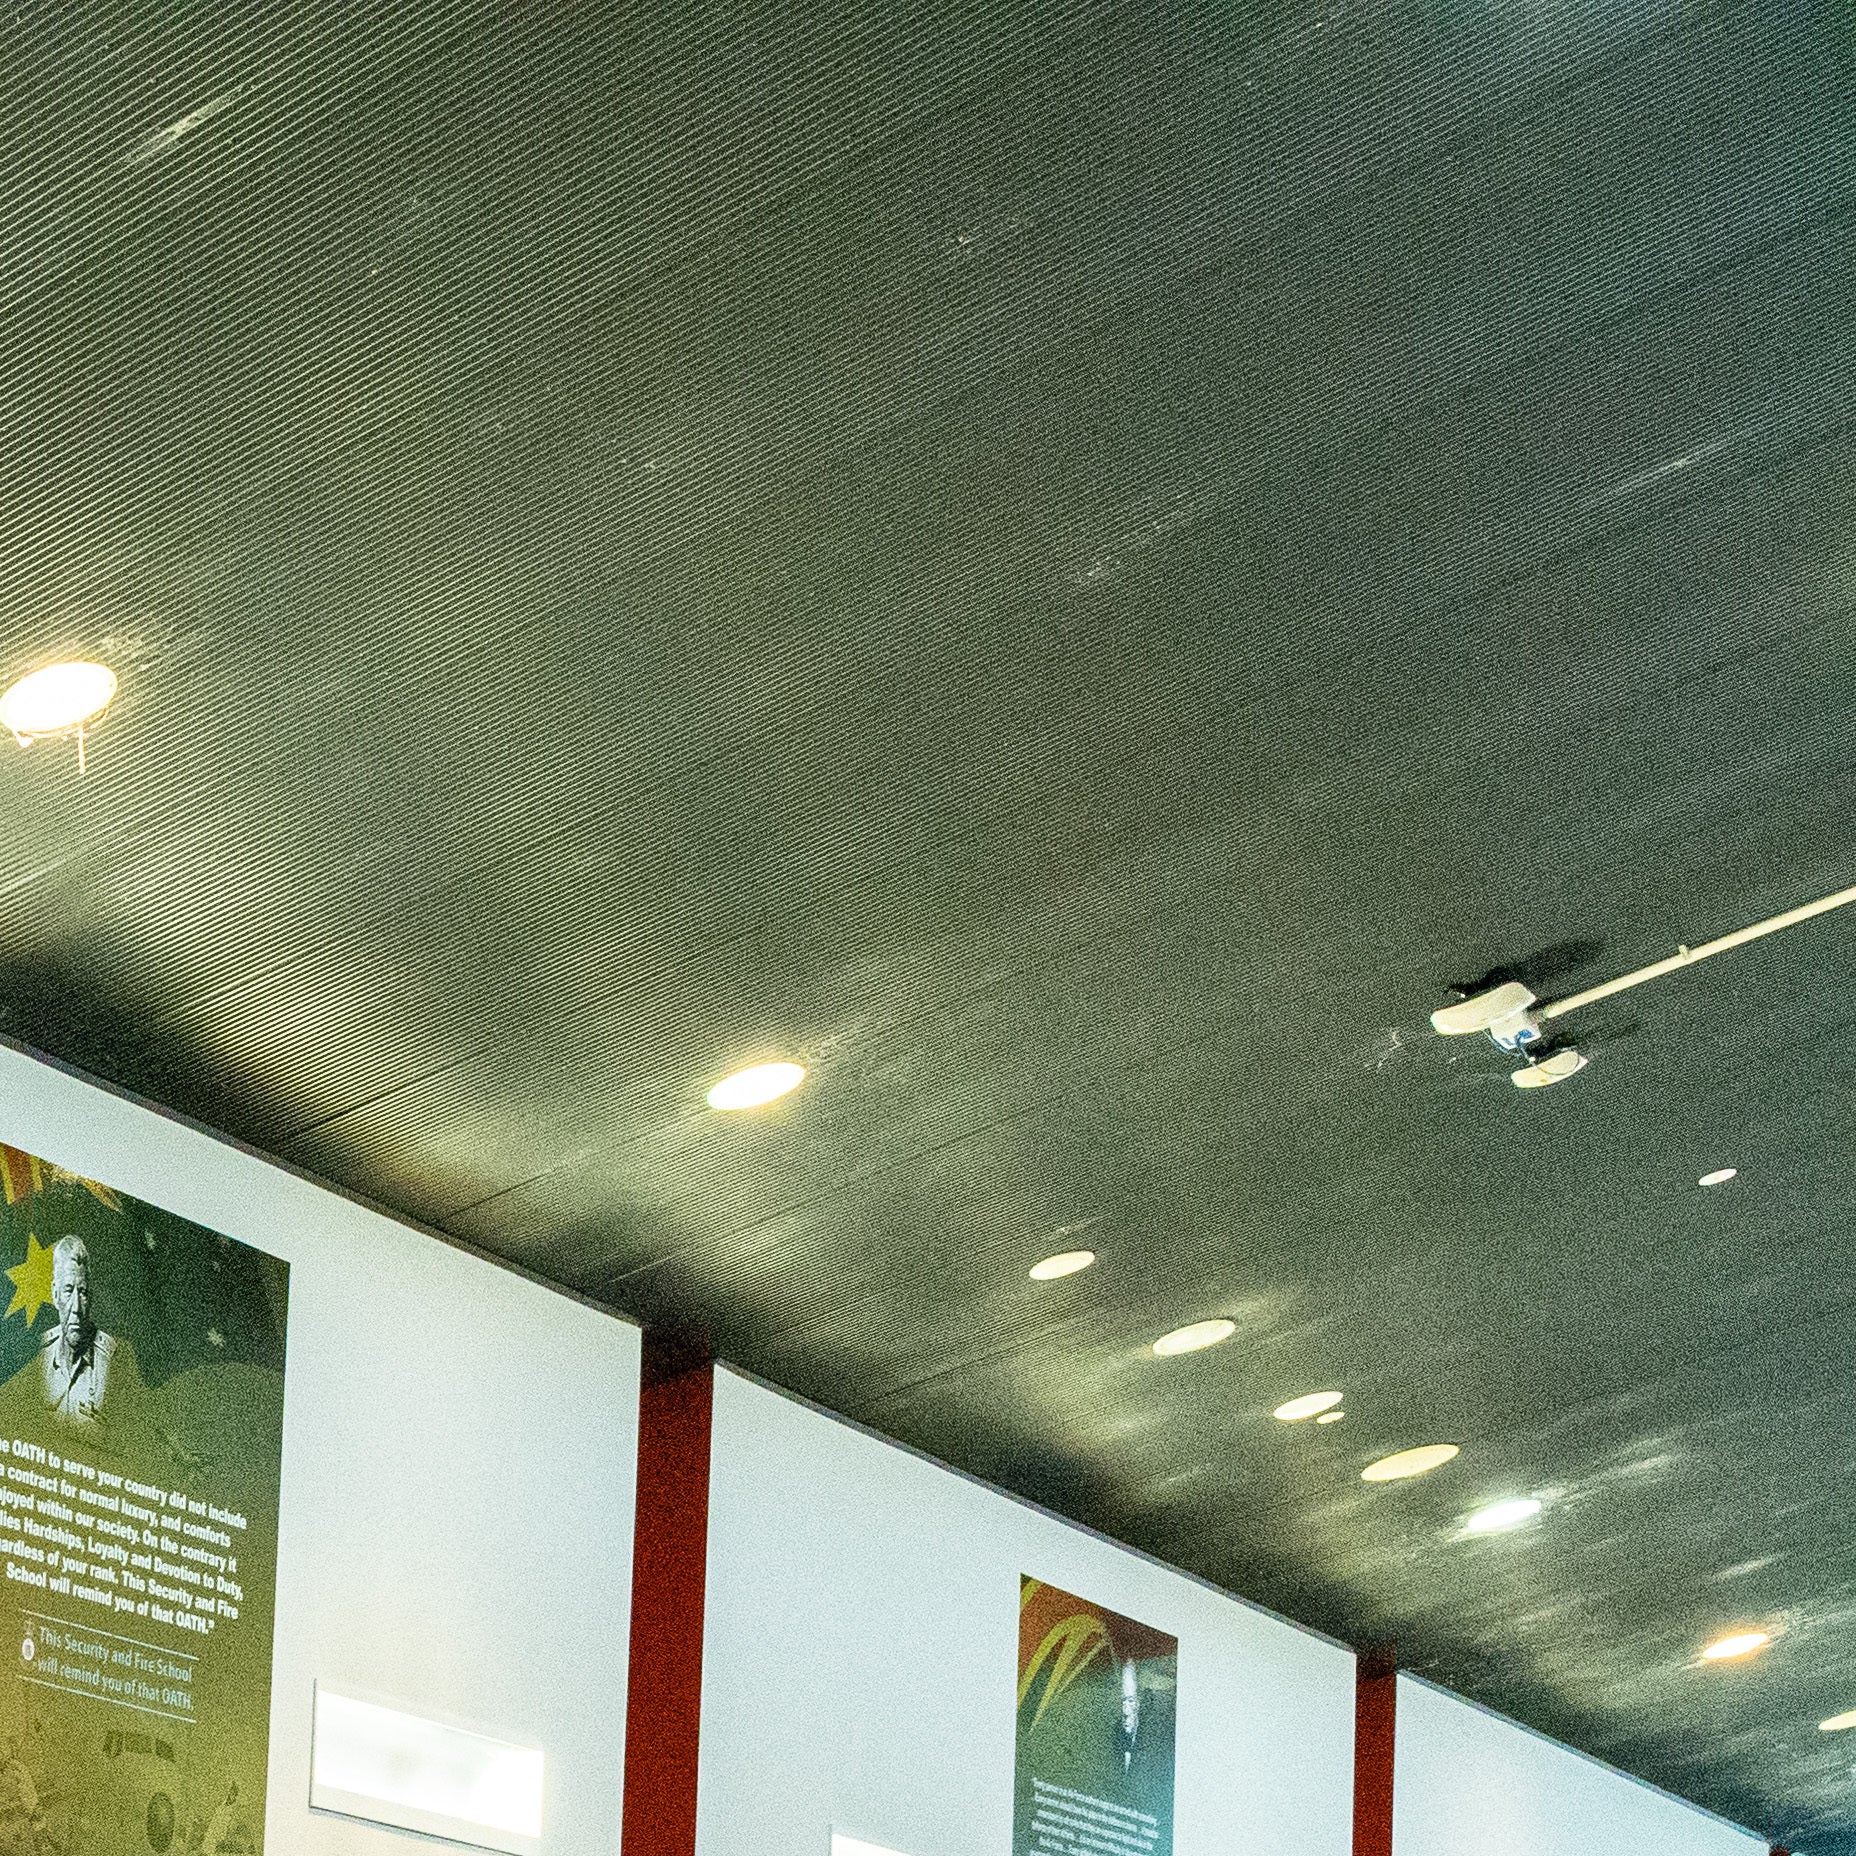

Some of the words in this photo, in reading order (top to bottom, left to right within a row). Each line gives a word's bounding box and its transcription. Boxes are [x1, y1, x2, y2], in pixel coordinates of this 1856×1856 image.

[8, 1467, 58, 1492] contract
[61, 1479, 77, 1498] for
[80, 1489, 119, 1511] normal
[121, 1499, 158, 1527] luxury,
[161, 1515, 181, 1531] and
[183, 1523, 230, 1547] comforts
[12, 1440, 45, 1463] OATH
[49, 1452, 60, 1468] to
[64, 1460, 95, 1479] serve
[98, 1471, 123, 1488] your
[125, 1479, 167, 1506] country
[169, 1491, 186, 1509] did
[189, 1501, 206, 1516] not
[209, 1504, 246, 1529] include
[24, 1517, 84, 1552] Hardships,
[88, 1537, 128, 1566] Loyalty
[131, 1554, 151, 1569] and
[154, 1557, 200, 1584] Devotion
[203, 1573, 214, 1588] to
[217, 1576, 243, 1600] Duty,
[37, 1500, 73, 1521] within
[75, 1512, 95, 1527] our
[97, 1519, 140, 1545] society.
[143, 1530, 158, 1548] On
[161, 1536, 178, 1554] the
[181, 1546, 226, 1572] contrary
[228, 1557, 236, 1572] it
[7, 1562, 46, 1587] School
[49, 1577, 70, 1594] will
[73, 1585, 112, 1606] remind
[115, 1597, 134, 1612] you
[137, 1601, 148, 1616] of
[151, 1605, 174, 1624] that
[47, 1551, 59, 1566] of
[62, 1557, 88, 1574] your
[90, 1565, 118, 1583] rank.
[122, 1570, 145, 1591] This
[148, 1579, 193, 1609] Security
[195, 1597, 215, 1612] and
[218, 1600, 238, 1619] Fire
